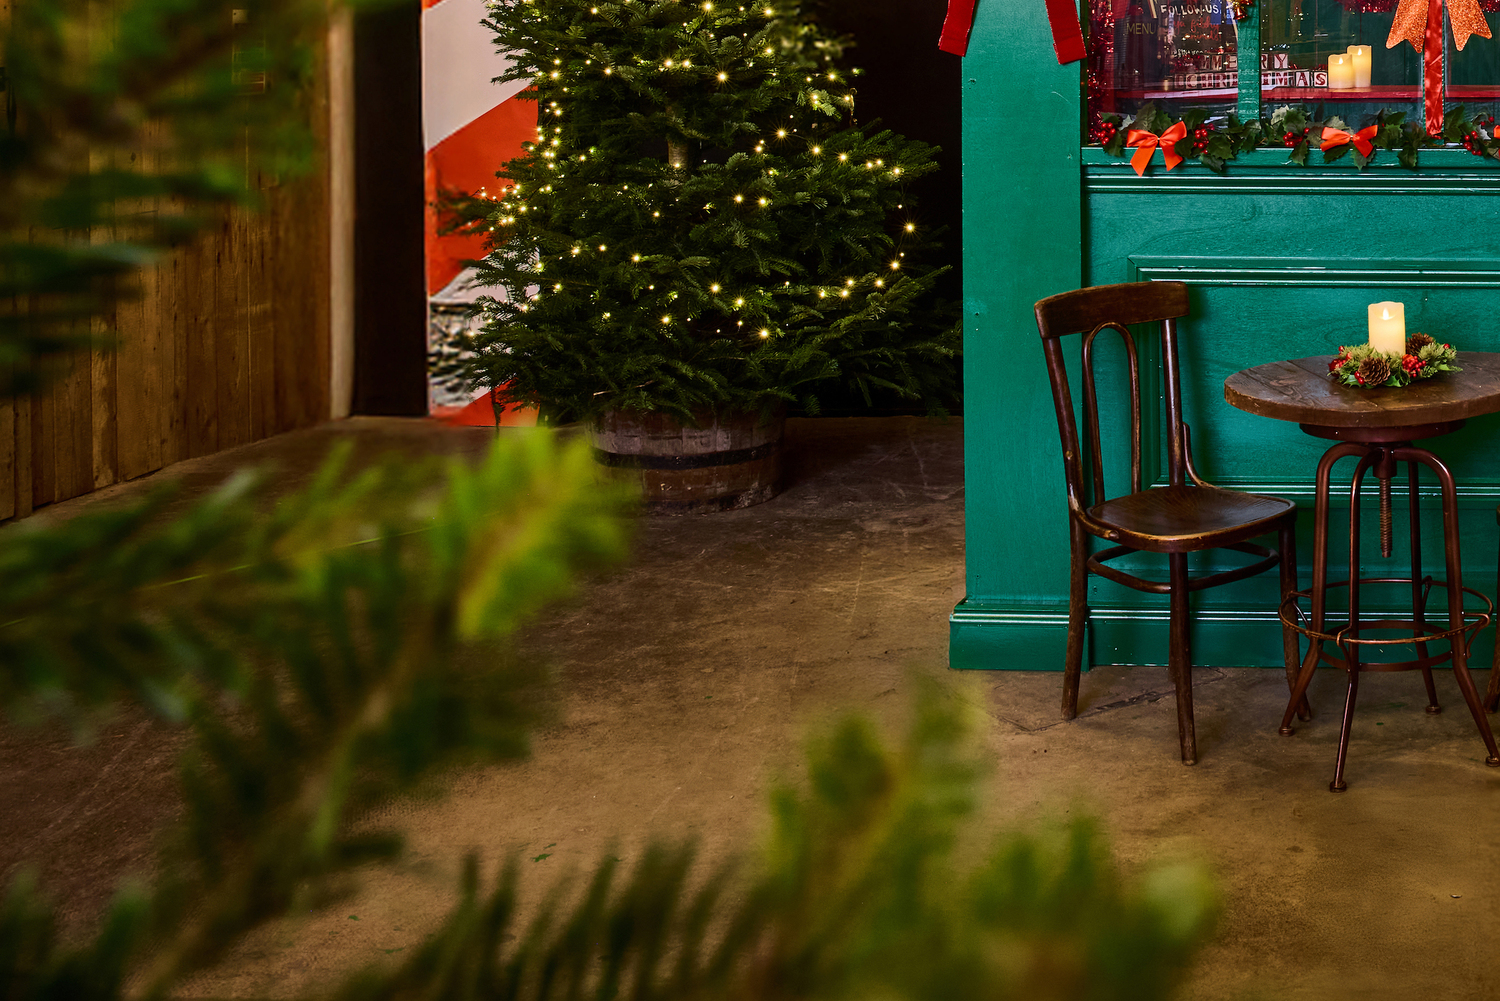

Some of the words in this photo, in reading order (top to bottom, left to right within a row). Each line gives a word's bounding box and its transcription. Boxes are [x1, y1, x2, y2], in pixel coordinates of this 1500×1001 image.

[1160, 4, 1202, 16] FOLLOW
[1126, 22, 1156, 34] MENU
[1211, 53, 1288, 70] MERY
